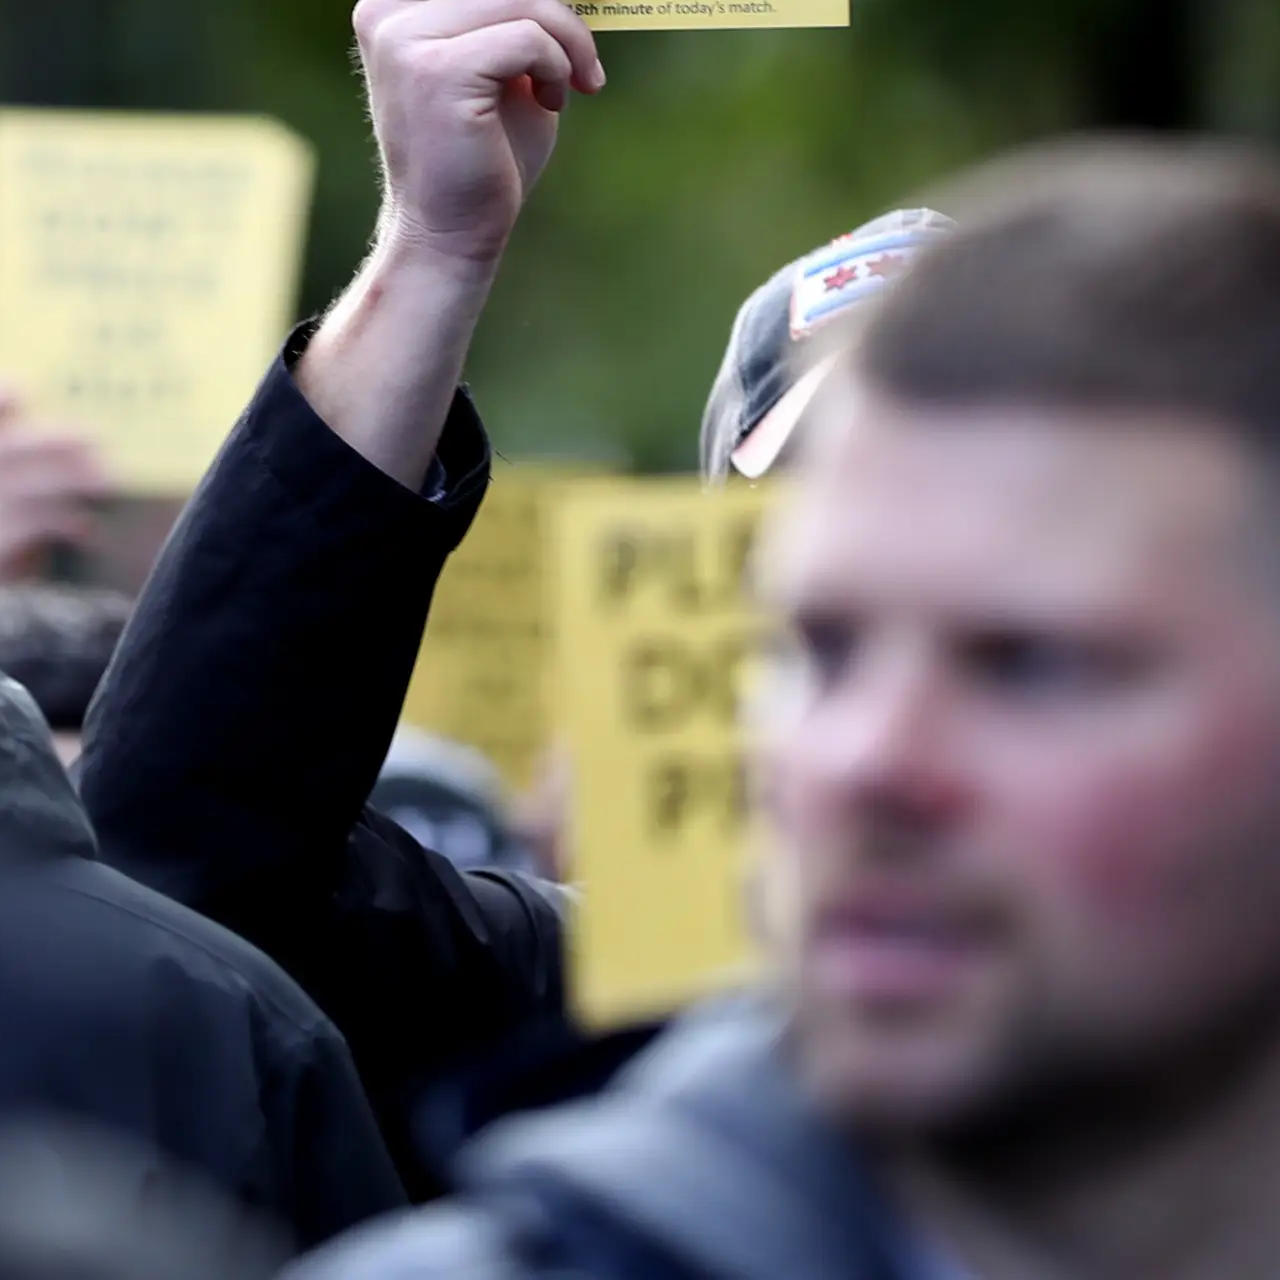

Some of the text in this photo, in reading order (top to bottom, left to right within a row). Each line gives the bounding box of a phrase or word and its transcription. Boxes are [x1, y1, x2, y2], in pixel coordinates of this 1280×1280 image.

[602, 1, 654, 16] minute
[656, 1, 672, 15] of
[728, 0, 777, 15] match.
